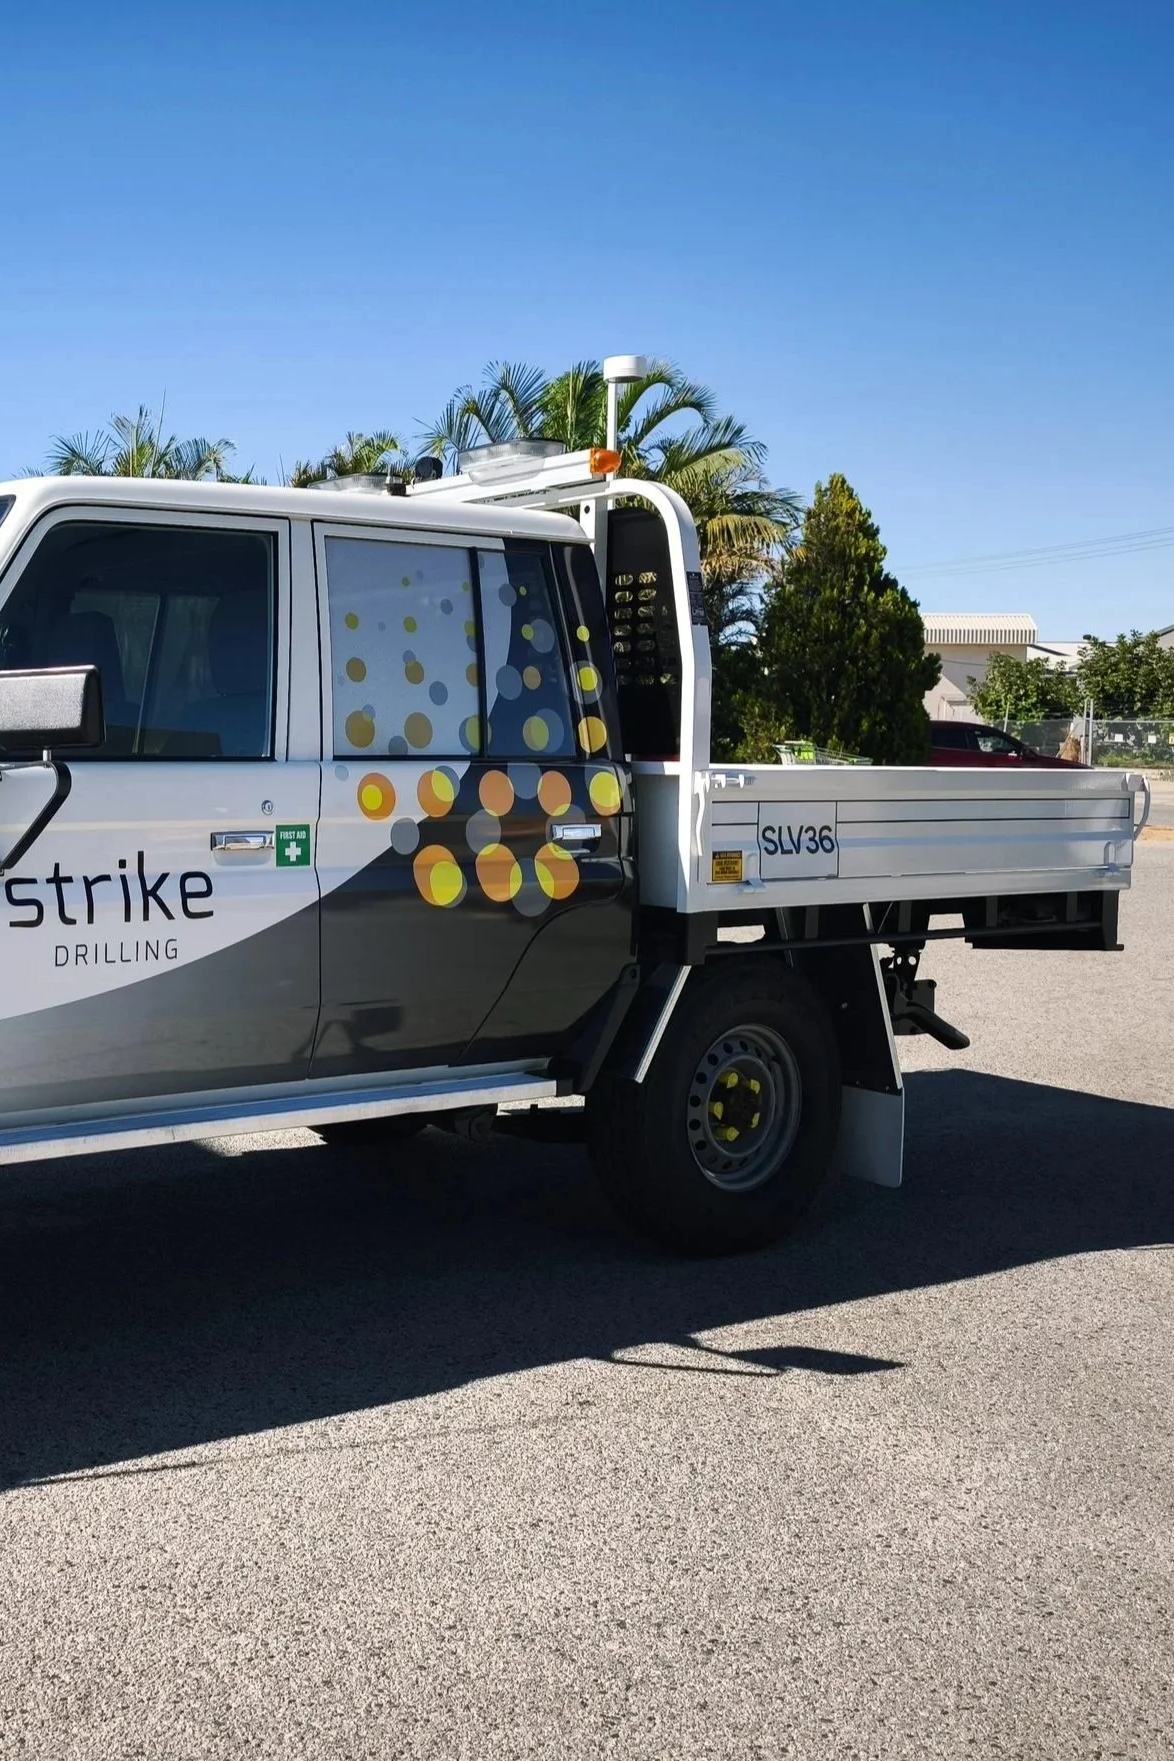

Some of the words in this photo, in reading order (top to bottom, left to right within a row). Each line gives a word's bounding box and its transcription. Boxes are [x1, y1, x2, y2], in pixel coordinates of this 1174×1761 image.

[280, 831, 296, 840] FIRST
[296, 830, 307, 840] AID
[761, 825, 836, 855] SLV36
[4, 850, 214, 928] strike
[54, 938, 178, 967] DRILLING
